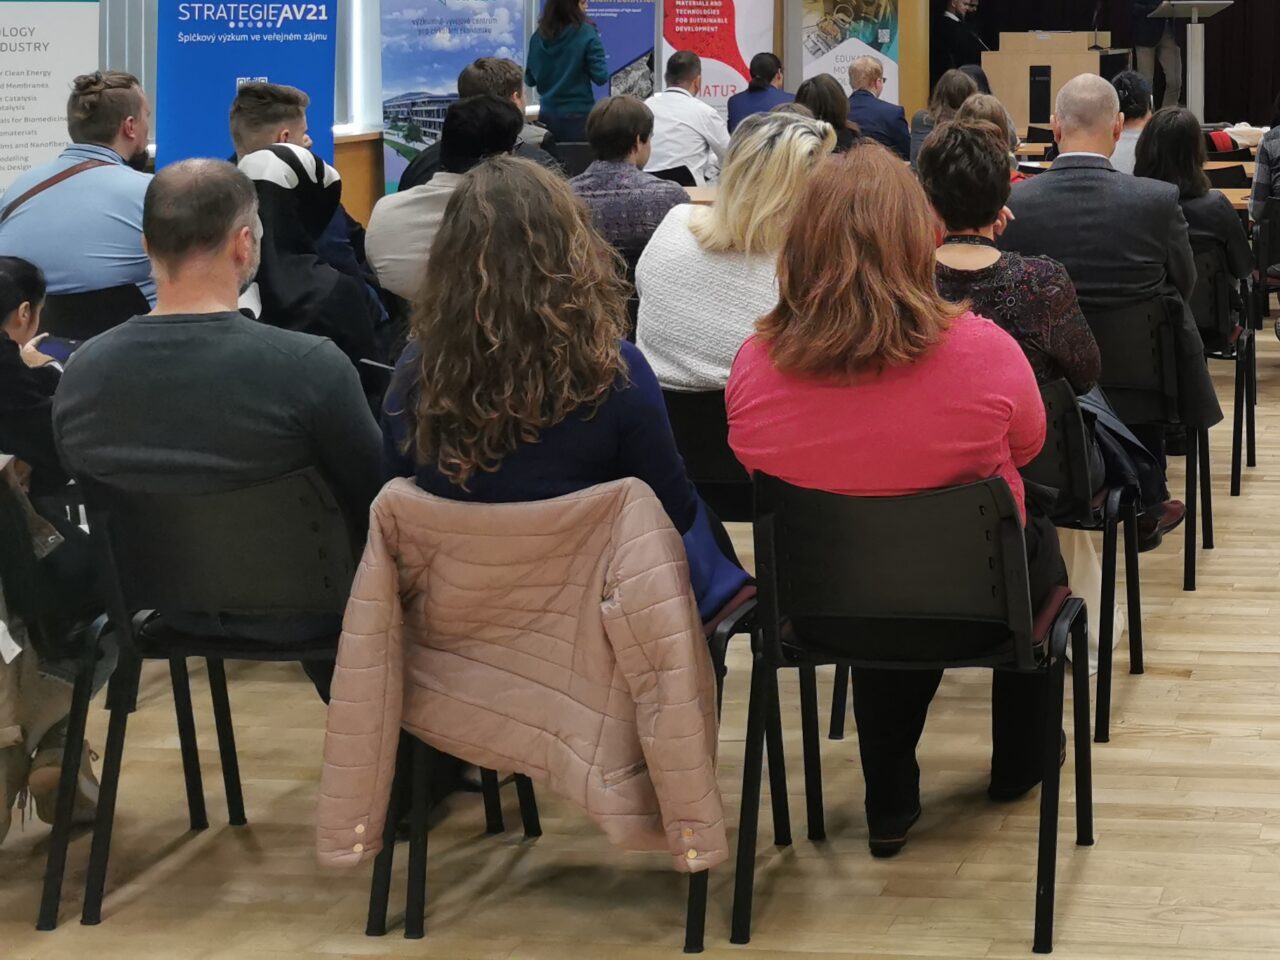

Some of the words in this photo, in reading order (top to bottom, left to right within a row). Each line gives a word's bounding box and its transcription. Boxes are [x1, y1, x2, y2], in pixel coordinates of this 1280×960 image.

[178, 32, 216, 43] Špičkový
[218, 33, 248, 42] výzkum
[263, 33, 301, 43] veřejném
[304, 33, 327, 42] zájmu
